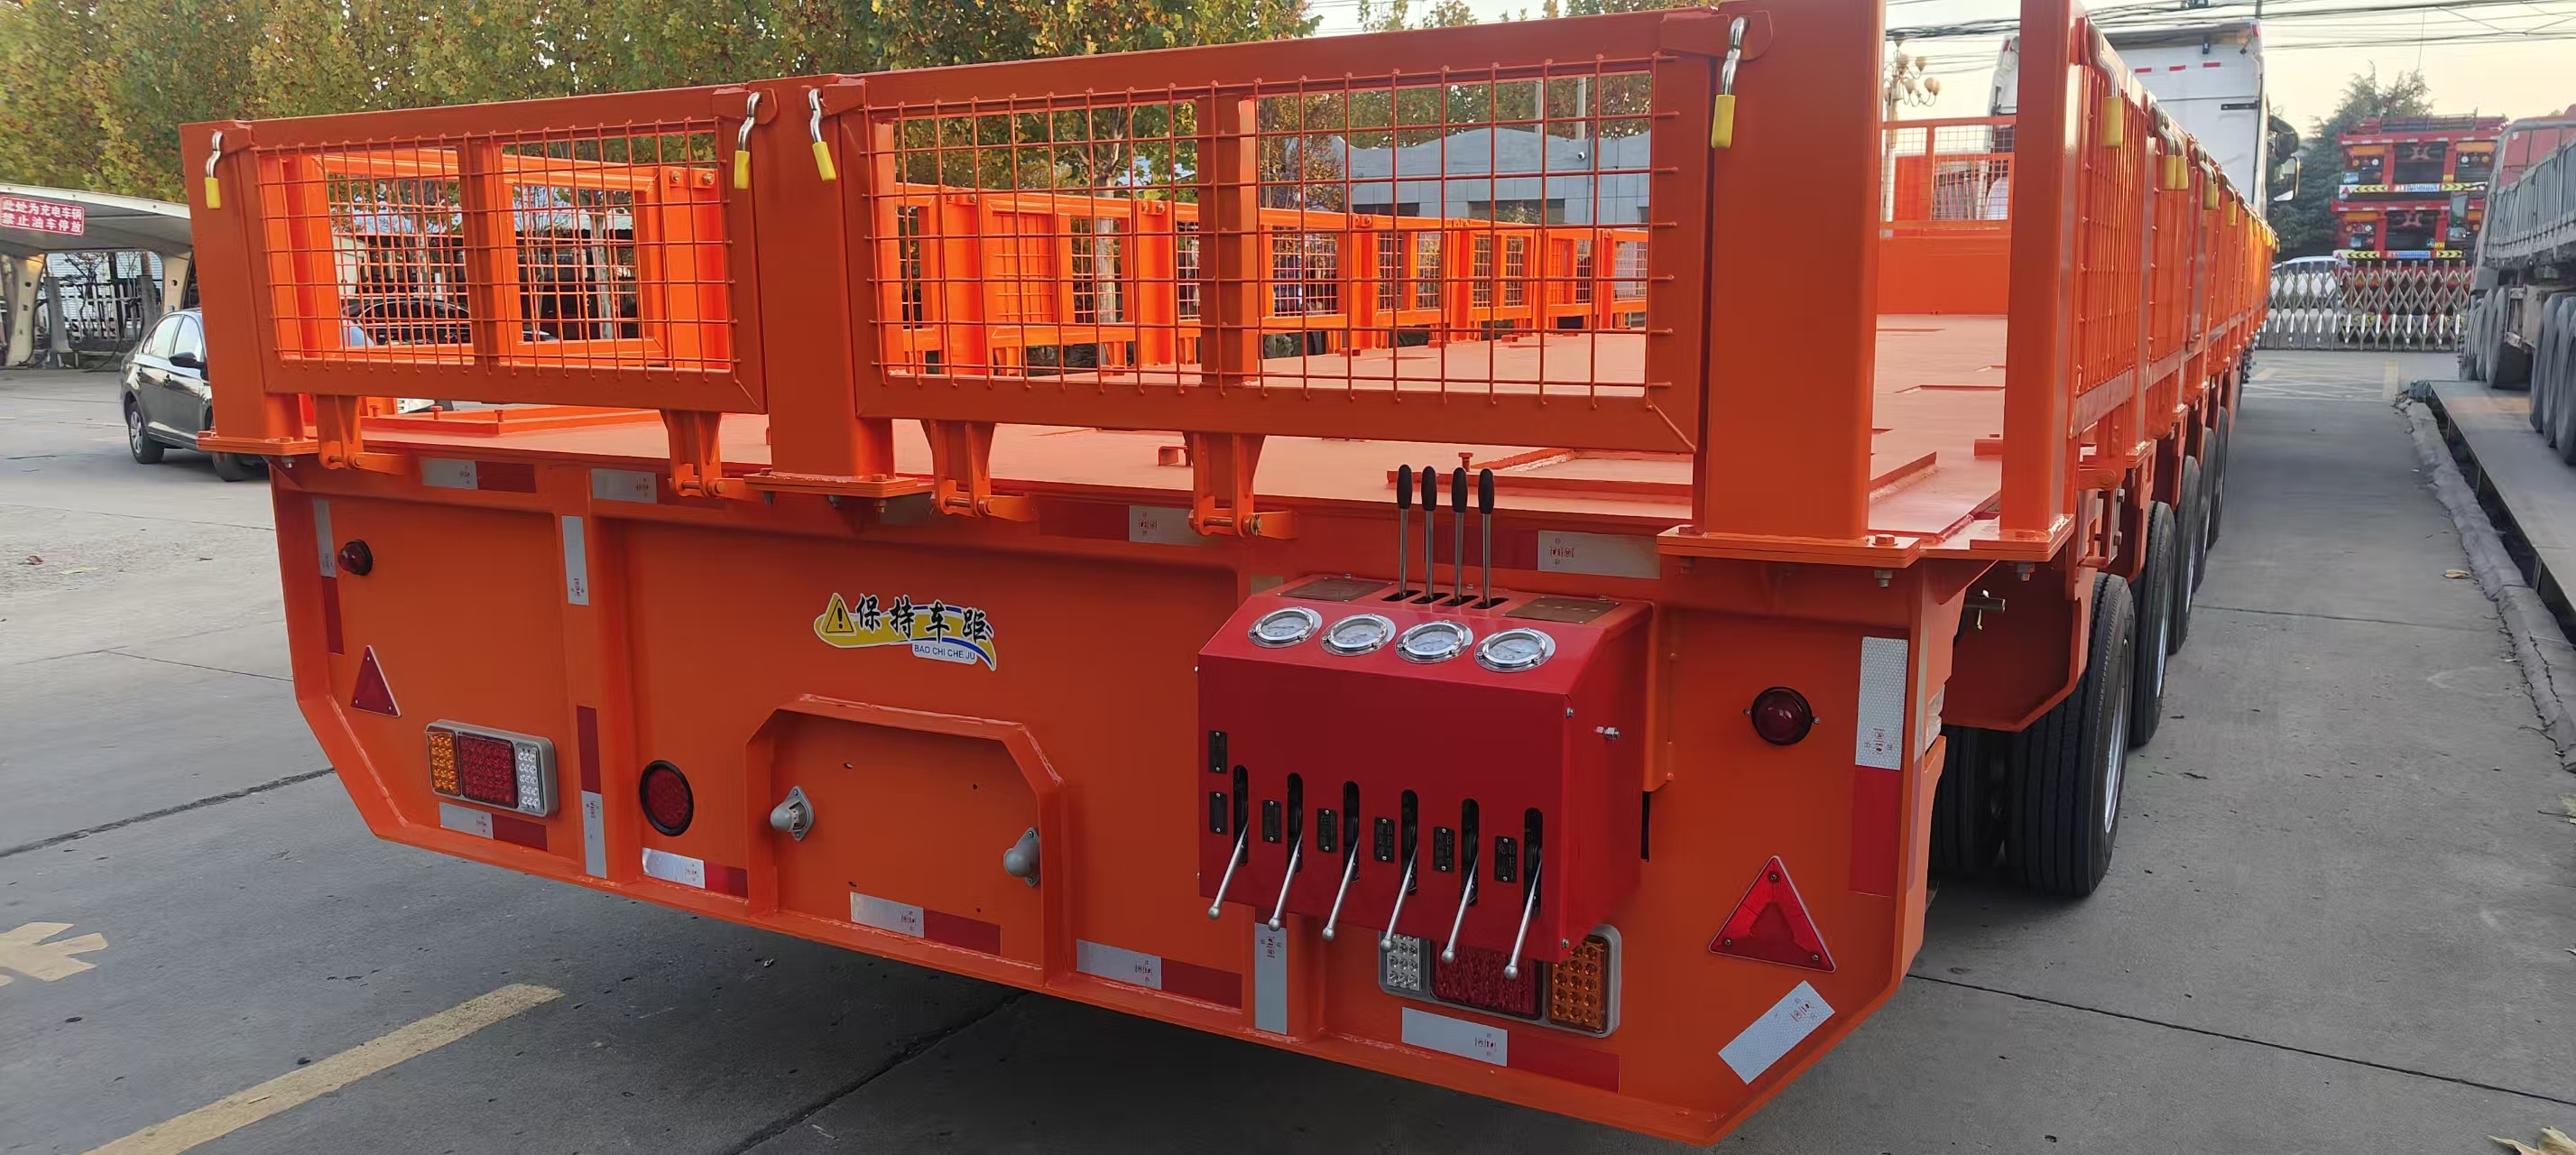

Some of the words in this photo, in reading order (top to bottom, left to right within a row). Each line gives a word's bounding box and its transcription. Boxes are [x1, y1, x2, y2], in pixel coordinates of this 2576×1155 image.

[3, 199, 82, 220] 此处为充电车辆
[2, 212, 81, 233] 禁止油车停放
[856, 595, 988, 643] 保持车距
[914, 644, 931, 654] BAO
[932, 646, 946, 657] CHI
[947, 649, 964, 659] CHE
[965, 651, 976, 661] JU
